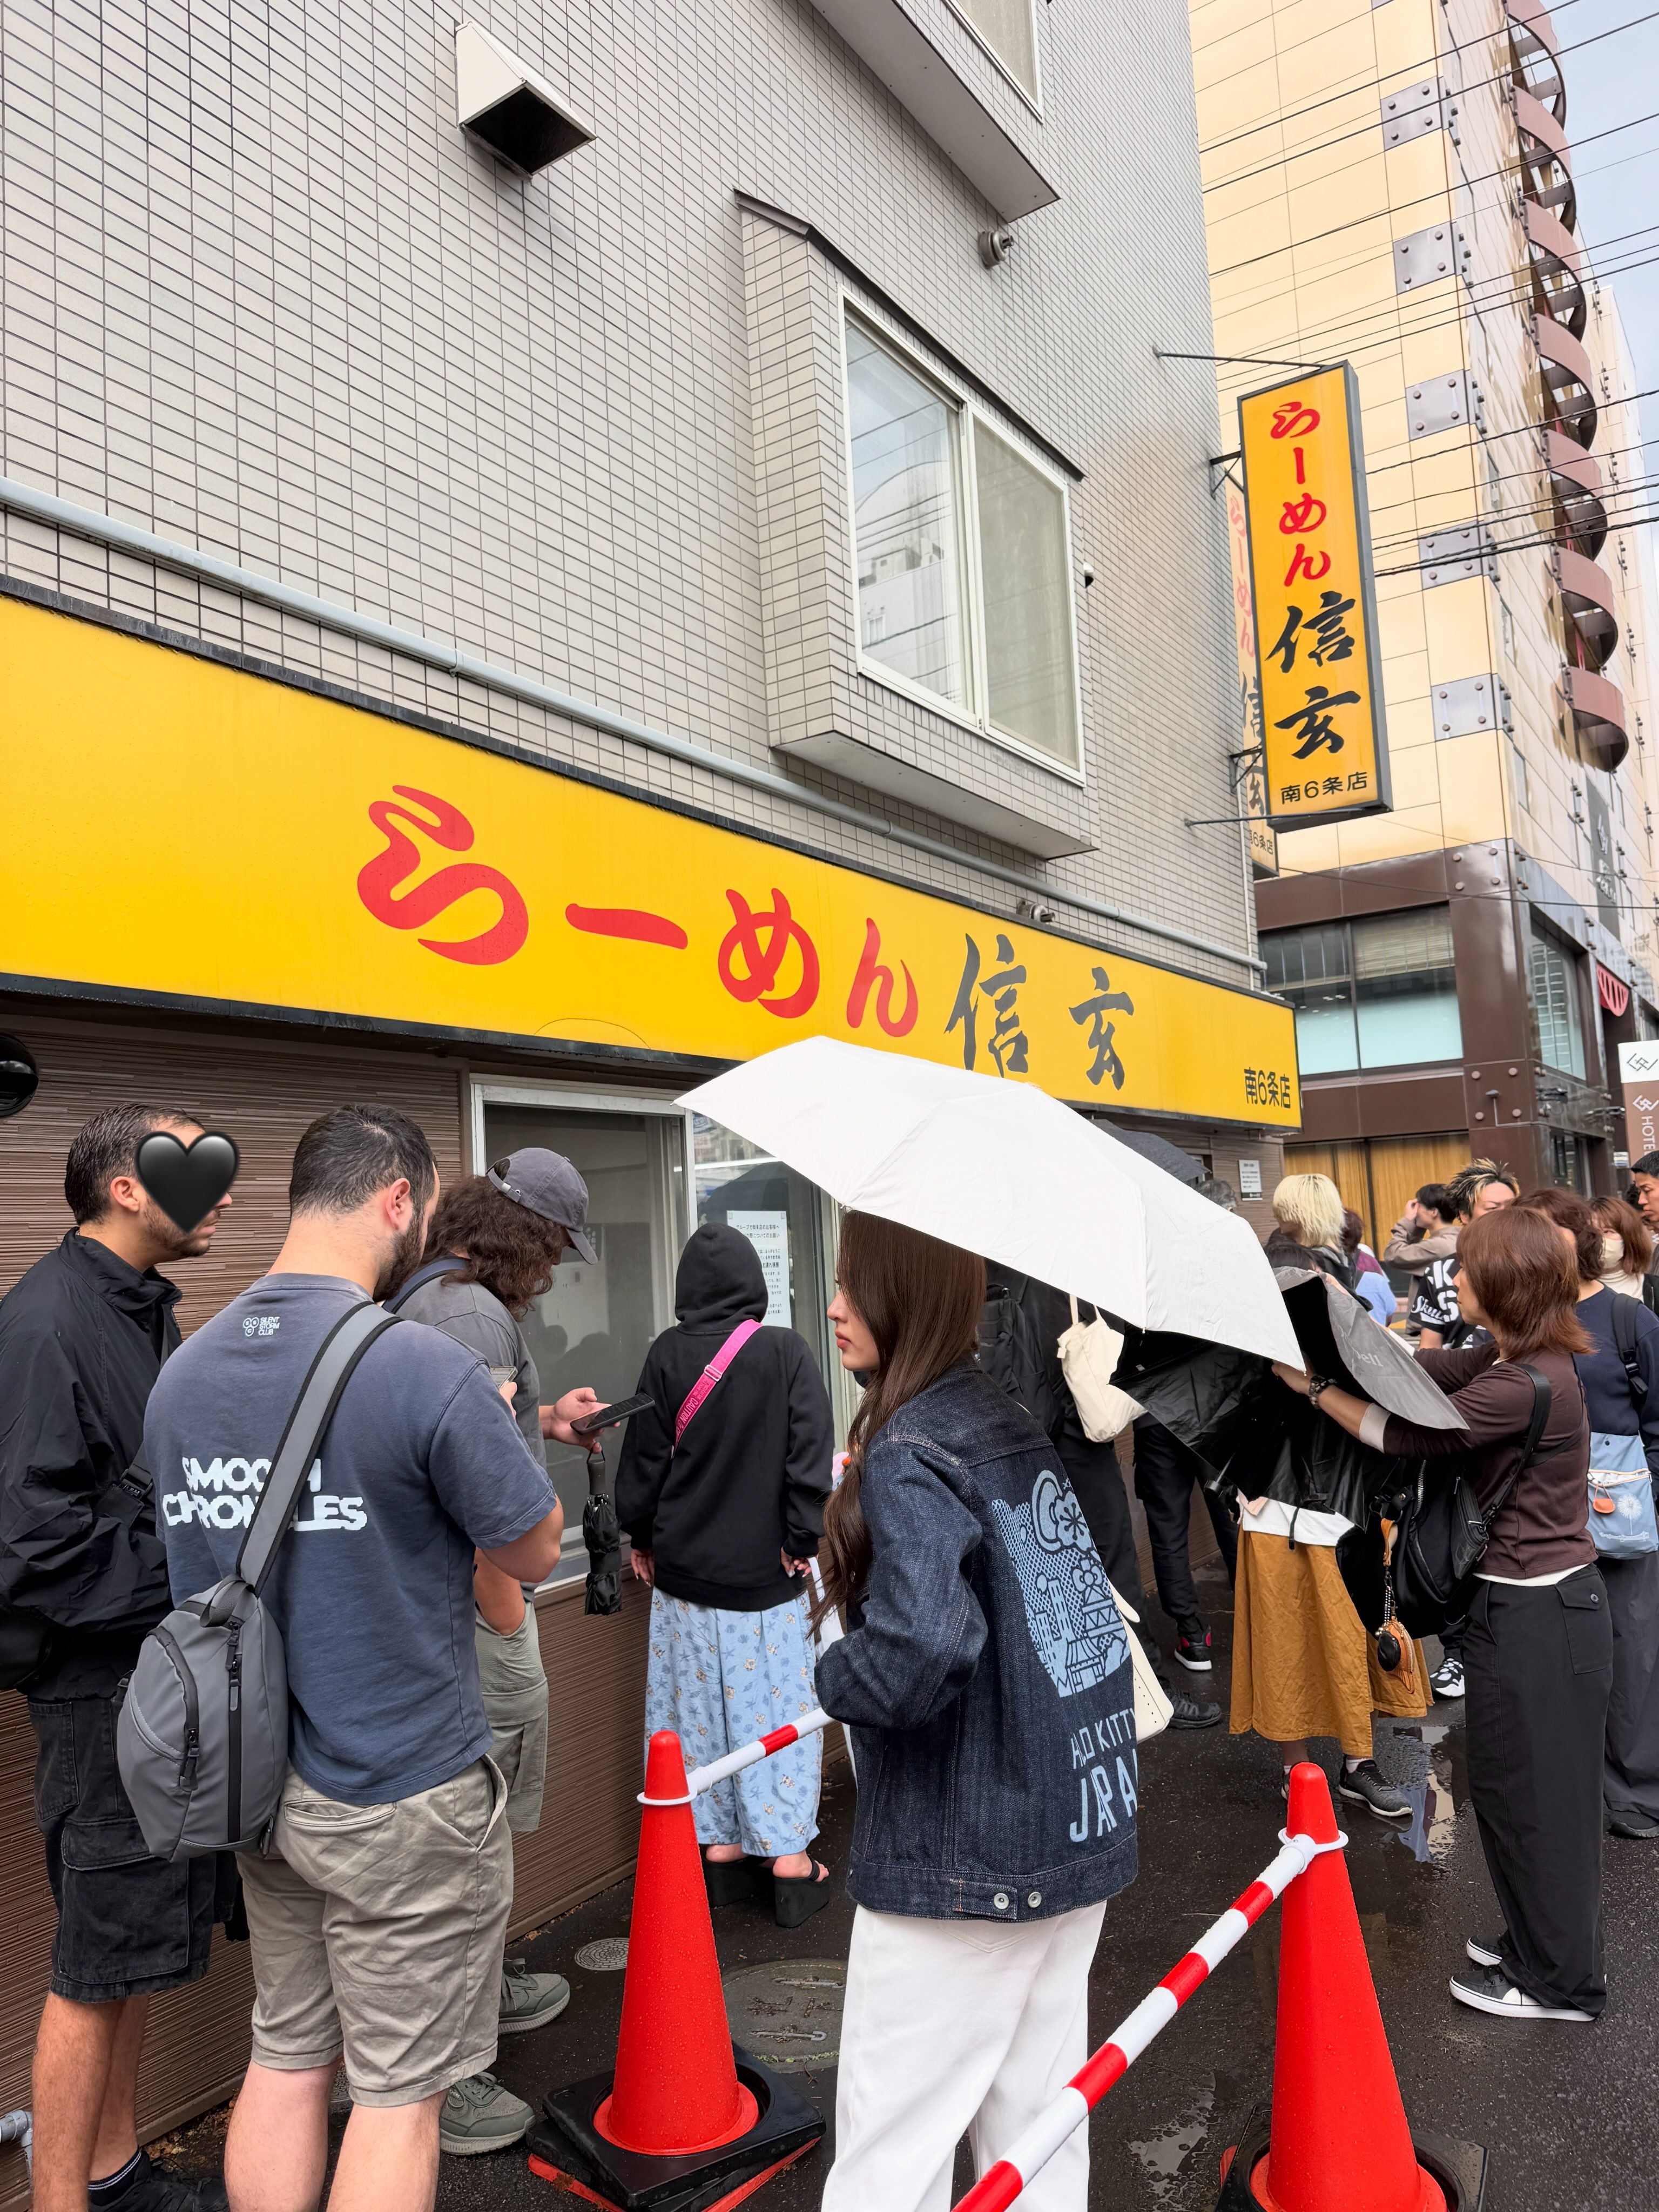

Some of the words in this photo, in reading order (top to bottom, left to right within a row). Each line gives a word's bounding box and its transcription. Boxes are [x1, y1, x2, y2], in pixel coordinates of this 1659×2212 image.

[1280, 771, 1368, 804] 南6条店
[1244, 1067, 1291, 1109] 南6条店
[1641, 1116, 1656, 1156] HOTE
[679, 1397, 698, 1424] CAUTION
[1070, 1749, 1138, 1843] JAPA
